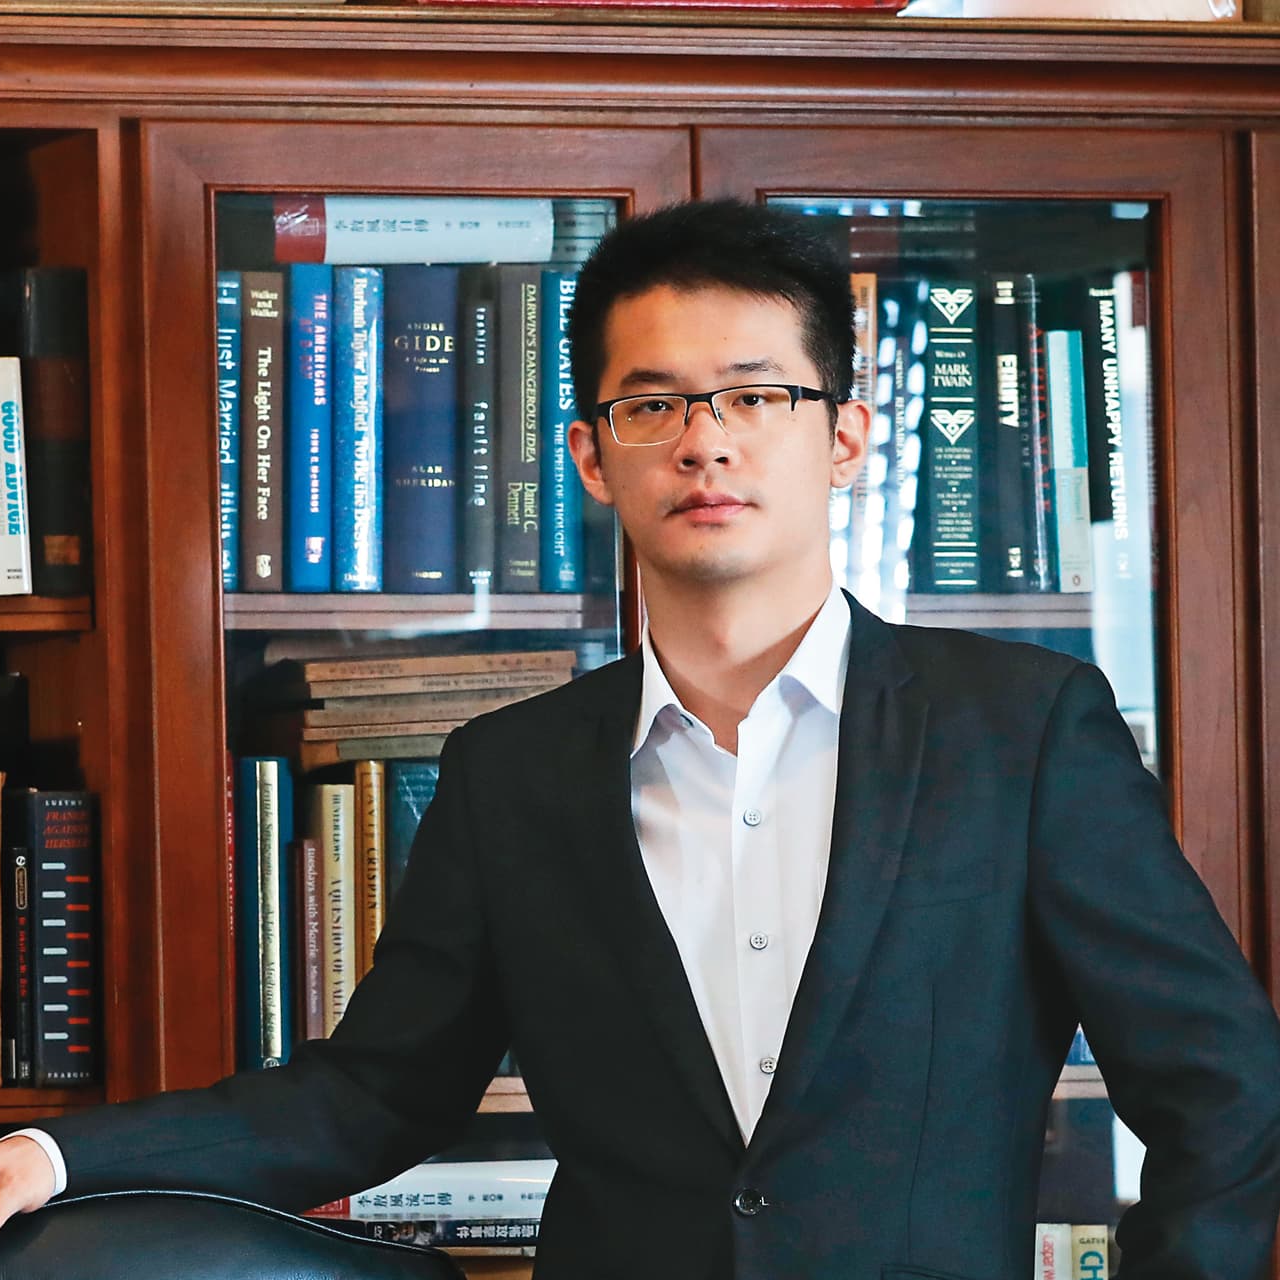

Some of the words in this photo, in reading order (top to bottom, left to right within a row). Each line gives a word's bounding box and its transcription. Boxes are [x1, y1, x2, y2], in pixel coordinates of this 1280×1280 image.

[314, 294, 327, 319] THE
[526, 284, 537, 348] DARWIN'S
[394, 335, 455, 352] GIDE
[1099, 300, 1116, 352] MANY
[258, 347, 272, 377] The
[314, 325, 327, 405] AMERICANS
[935, 364, 969, 375] MARK
[526, 350, 537, 427] DANGEROUS
[932, 375, 973, 387] TWAIN
[254, 382, 272, 420] Light
[1102, 358, 1122, 447] UNHAPPY
[219, 379, 237, 464] Married
[257, 425, 272, 449] On
[474, 401, 489, 456] fault
[554, 422, 565, 444] THE
[526, 431, 537, 463] IDEA
[554, 446, 565, 483] SPEED
[257, 455, 272, 482] Her
[474, 464, 489, 507] line
[257, 487, 271, 521] Face
[507, 482, 523, 525] Dennett
[524, 482, 538, 517] Daniel
[1109, 452, 1129, 541] RETURNS
[553, 503, 565, 556] THOUGHT
[367, 848, 378, 910] CRISPIN
[357, 1191, 453, 1209] 李敖風流自傳
